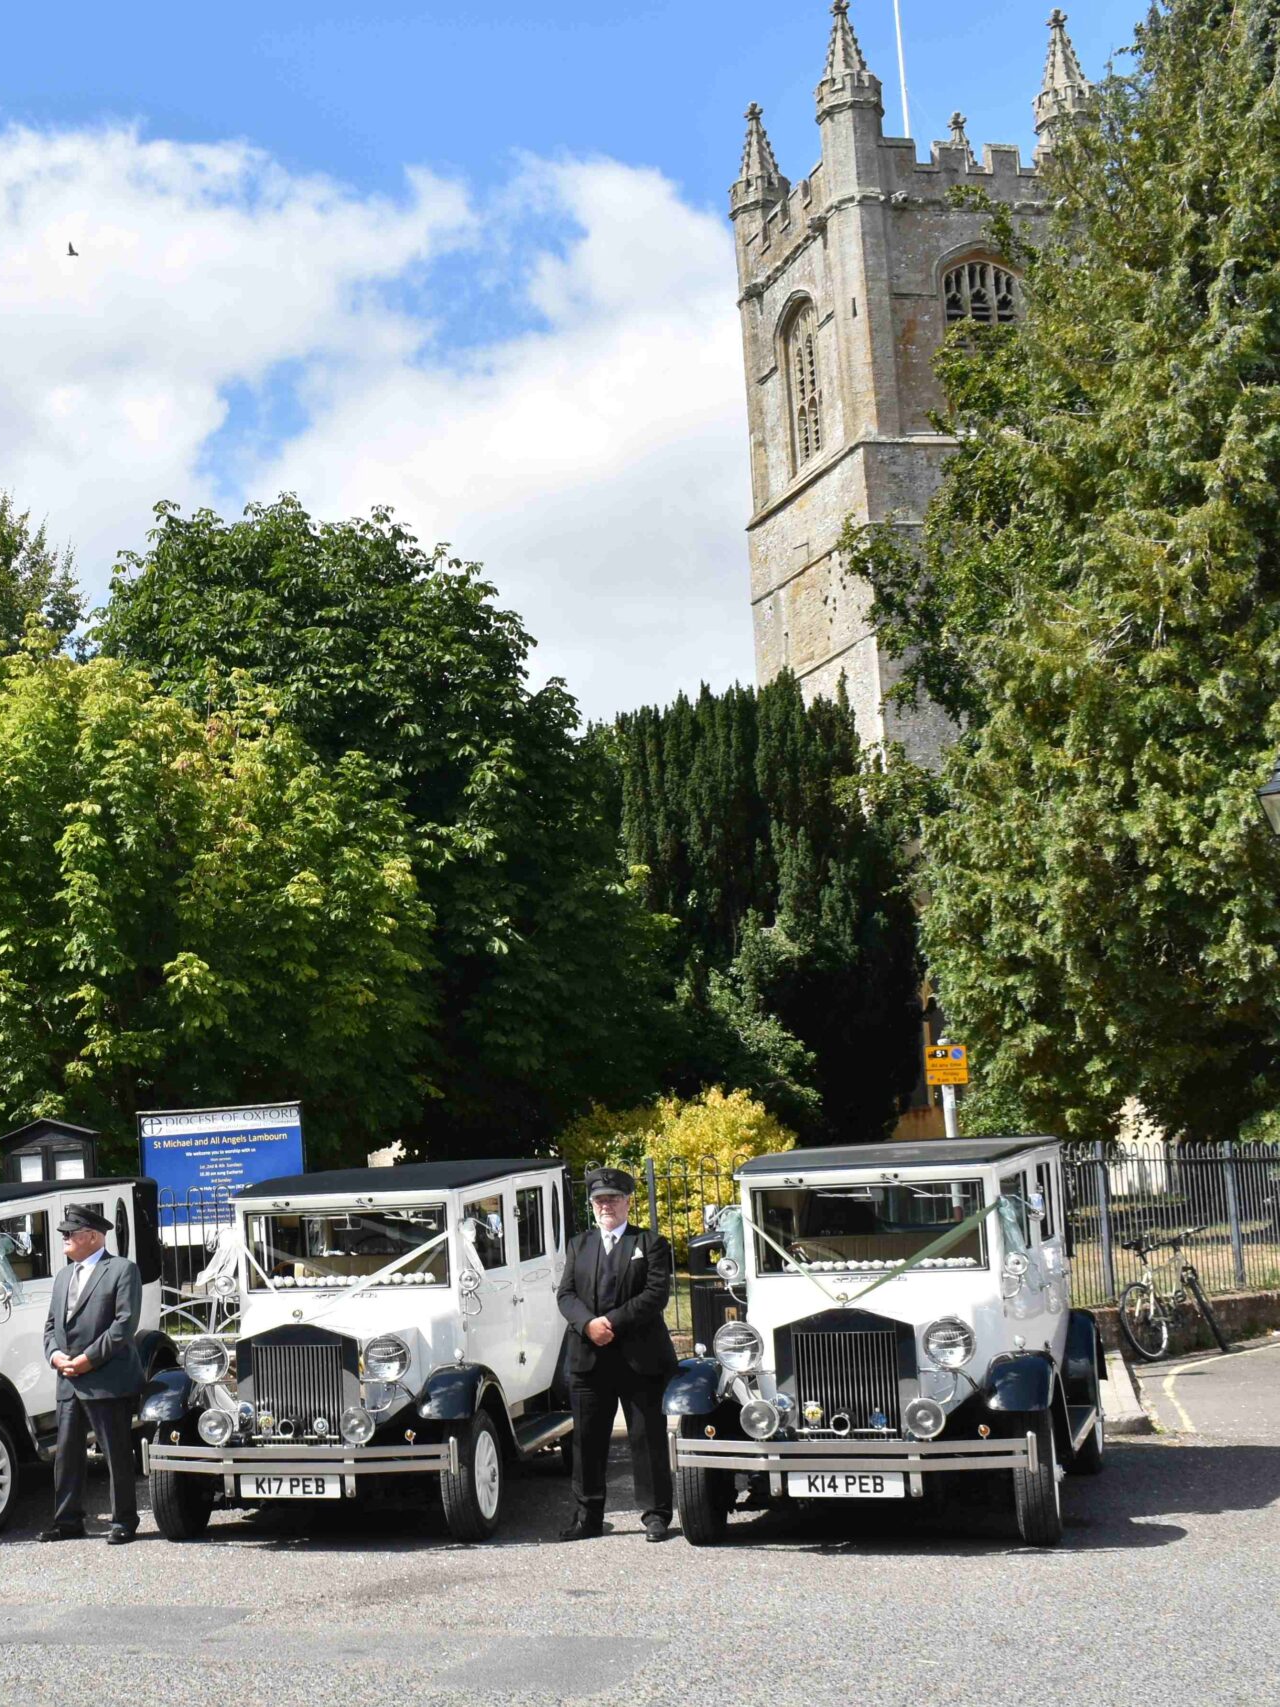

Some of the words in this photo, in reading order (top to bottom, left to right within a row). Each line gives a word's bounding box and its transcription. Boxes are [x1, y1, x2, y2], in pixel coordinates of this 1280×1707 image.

[166, 1114, 217, 1126] DIOCESE
[222, 1112, 239, 1122] OF
[243, 1107, 300, 1121] OXFORD
[153, 1140, 162, 1149] St
[163, 1138, 193, 1148] Michael
[194, 1137, 209, 1146] and
[210, 1136, 220, 1144] All
[222, 1134, 247, 1145] Angels
[248, 1132, 288, 1142] Lambourn
[255, 1477, 283, 1495] K17
[289, 1477, 325, 1495] PEB
[807, 1474, 838, 1493] K14
[844, 1474, 884, 1493] PEB
